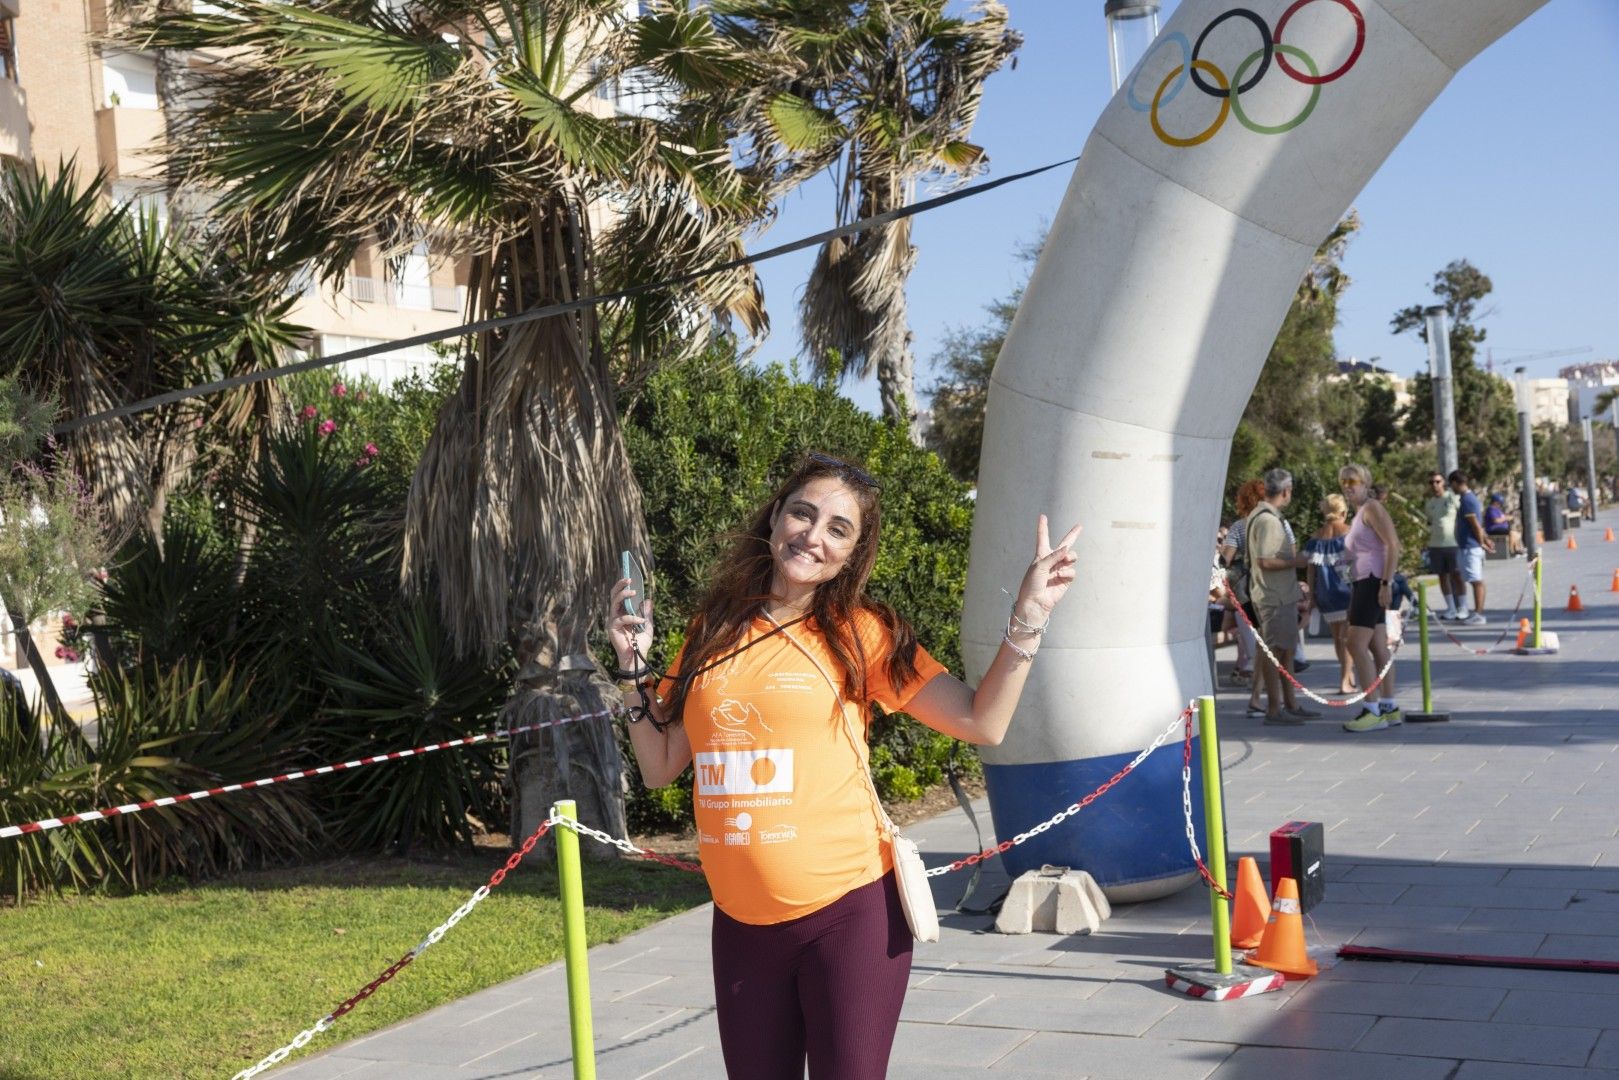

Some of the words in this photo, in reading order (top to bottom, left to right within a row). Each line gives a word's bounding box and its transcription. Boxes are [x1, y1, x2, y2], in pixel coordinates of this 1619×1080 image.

[701, 764, 726, 786] TM
[707, 799, 730, 811] Grupo
[731, 796, 793, 809] Inmobiliario
